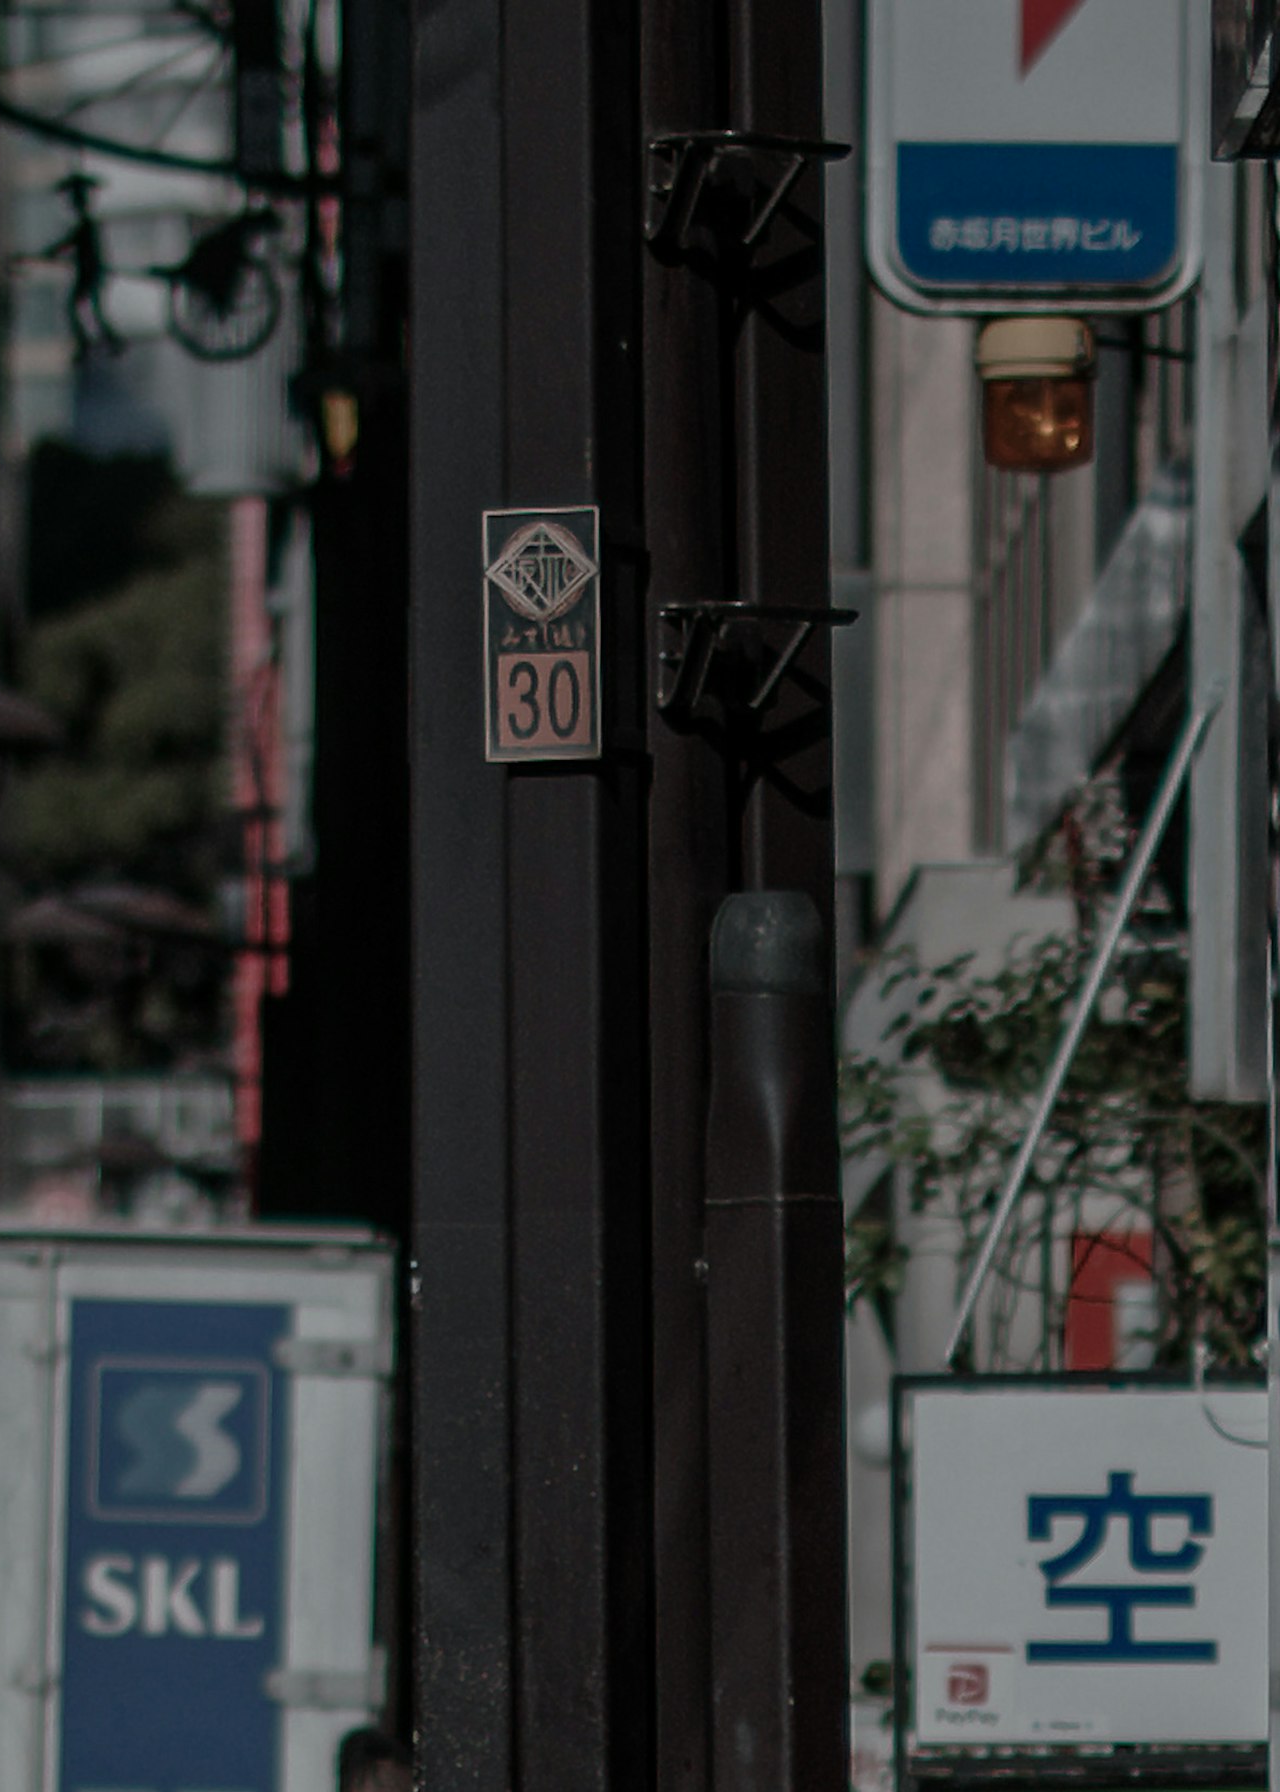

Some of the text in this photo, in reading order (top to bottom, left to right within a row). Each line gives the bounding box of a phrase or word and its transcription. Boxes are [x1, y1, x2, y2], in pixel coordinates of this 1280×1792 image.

[508, 661, 580, 740] 30
[81, 1553, 266, 1640] SKL
[1028, 1472, 1217, 1663] 空
